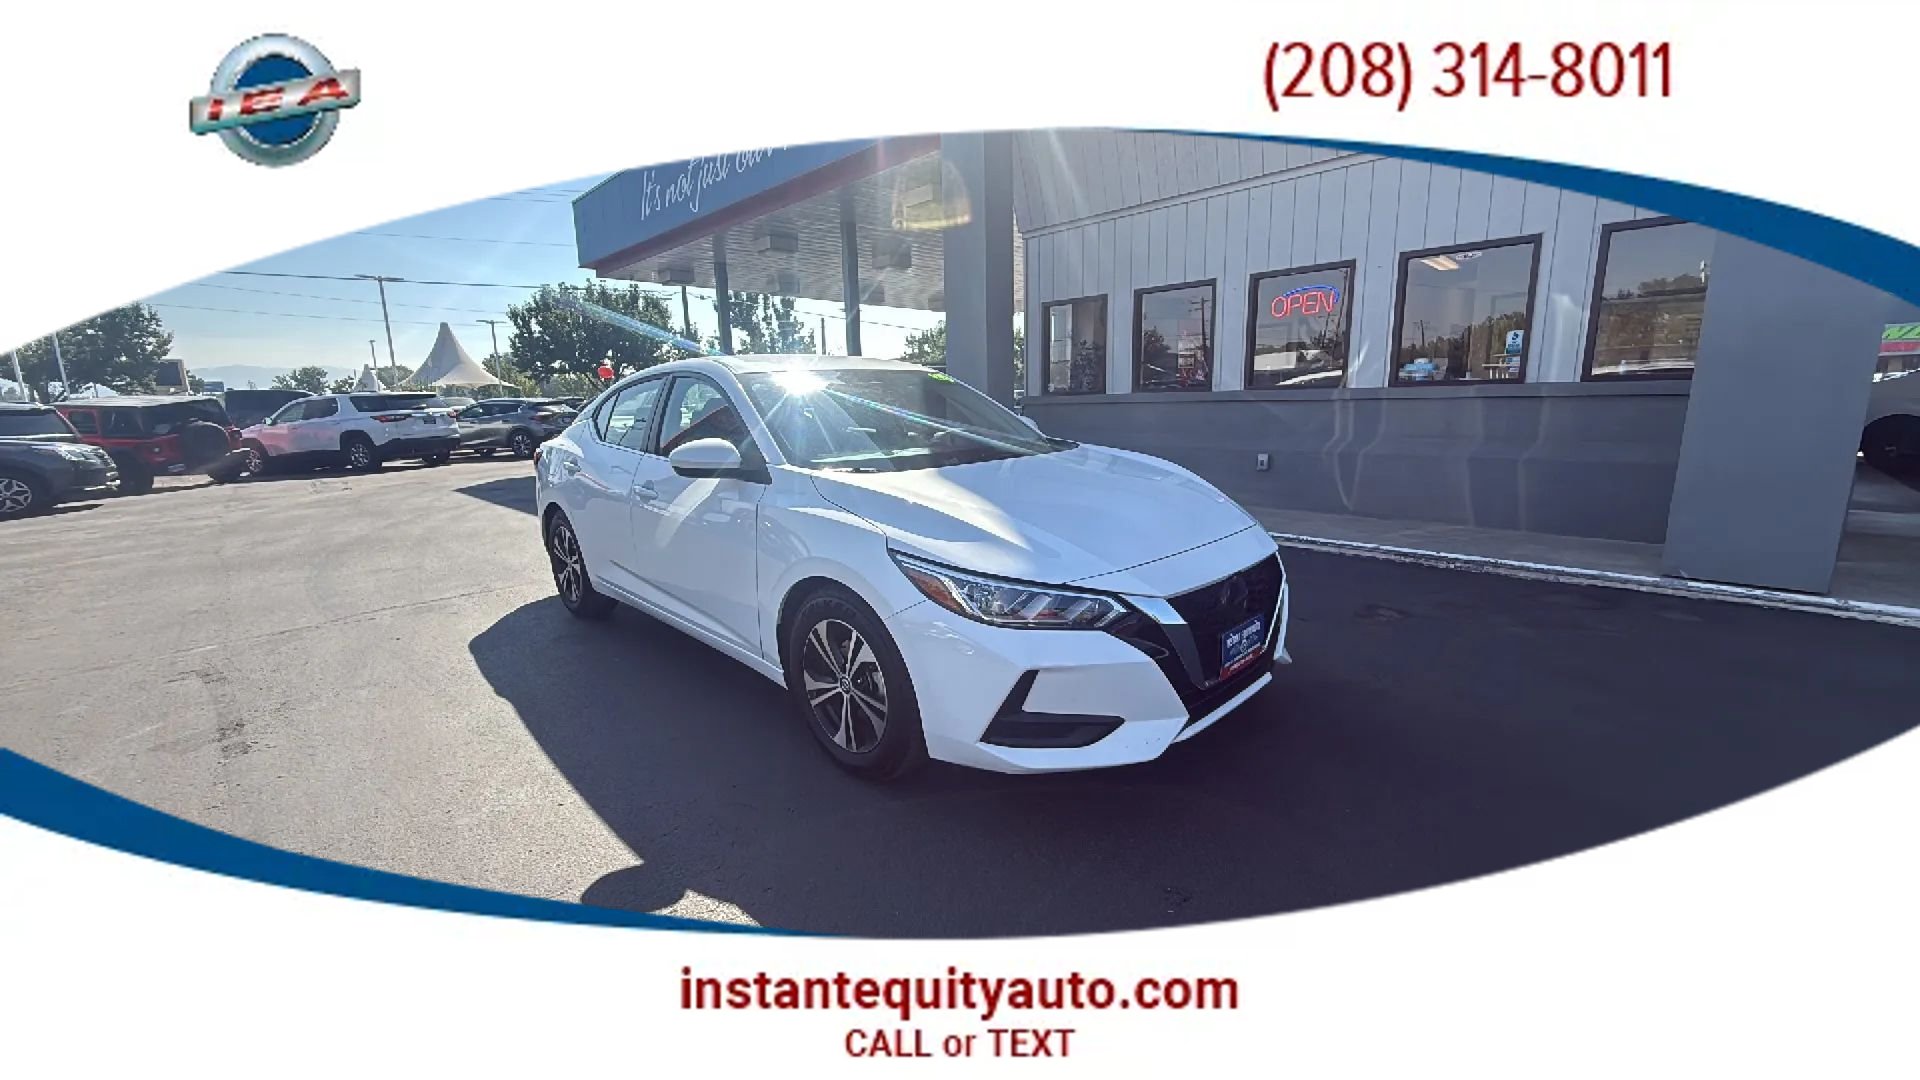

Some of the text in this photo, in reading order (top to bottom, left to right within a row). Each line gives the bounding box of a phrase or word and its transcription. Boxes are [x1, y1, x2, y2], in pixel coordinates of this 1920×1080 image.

[641, 169, 661, 221] It's
[666, 157, 695, 208] not
[689, 153, 731, 212] just
[1271, 290, 1335, 318] OPEN
